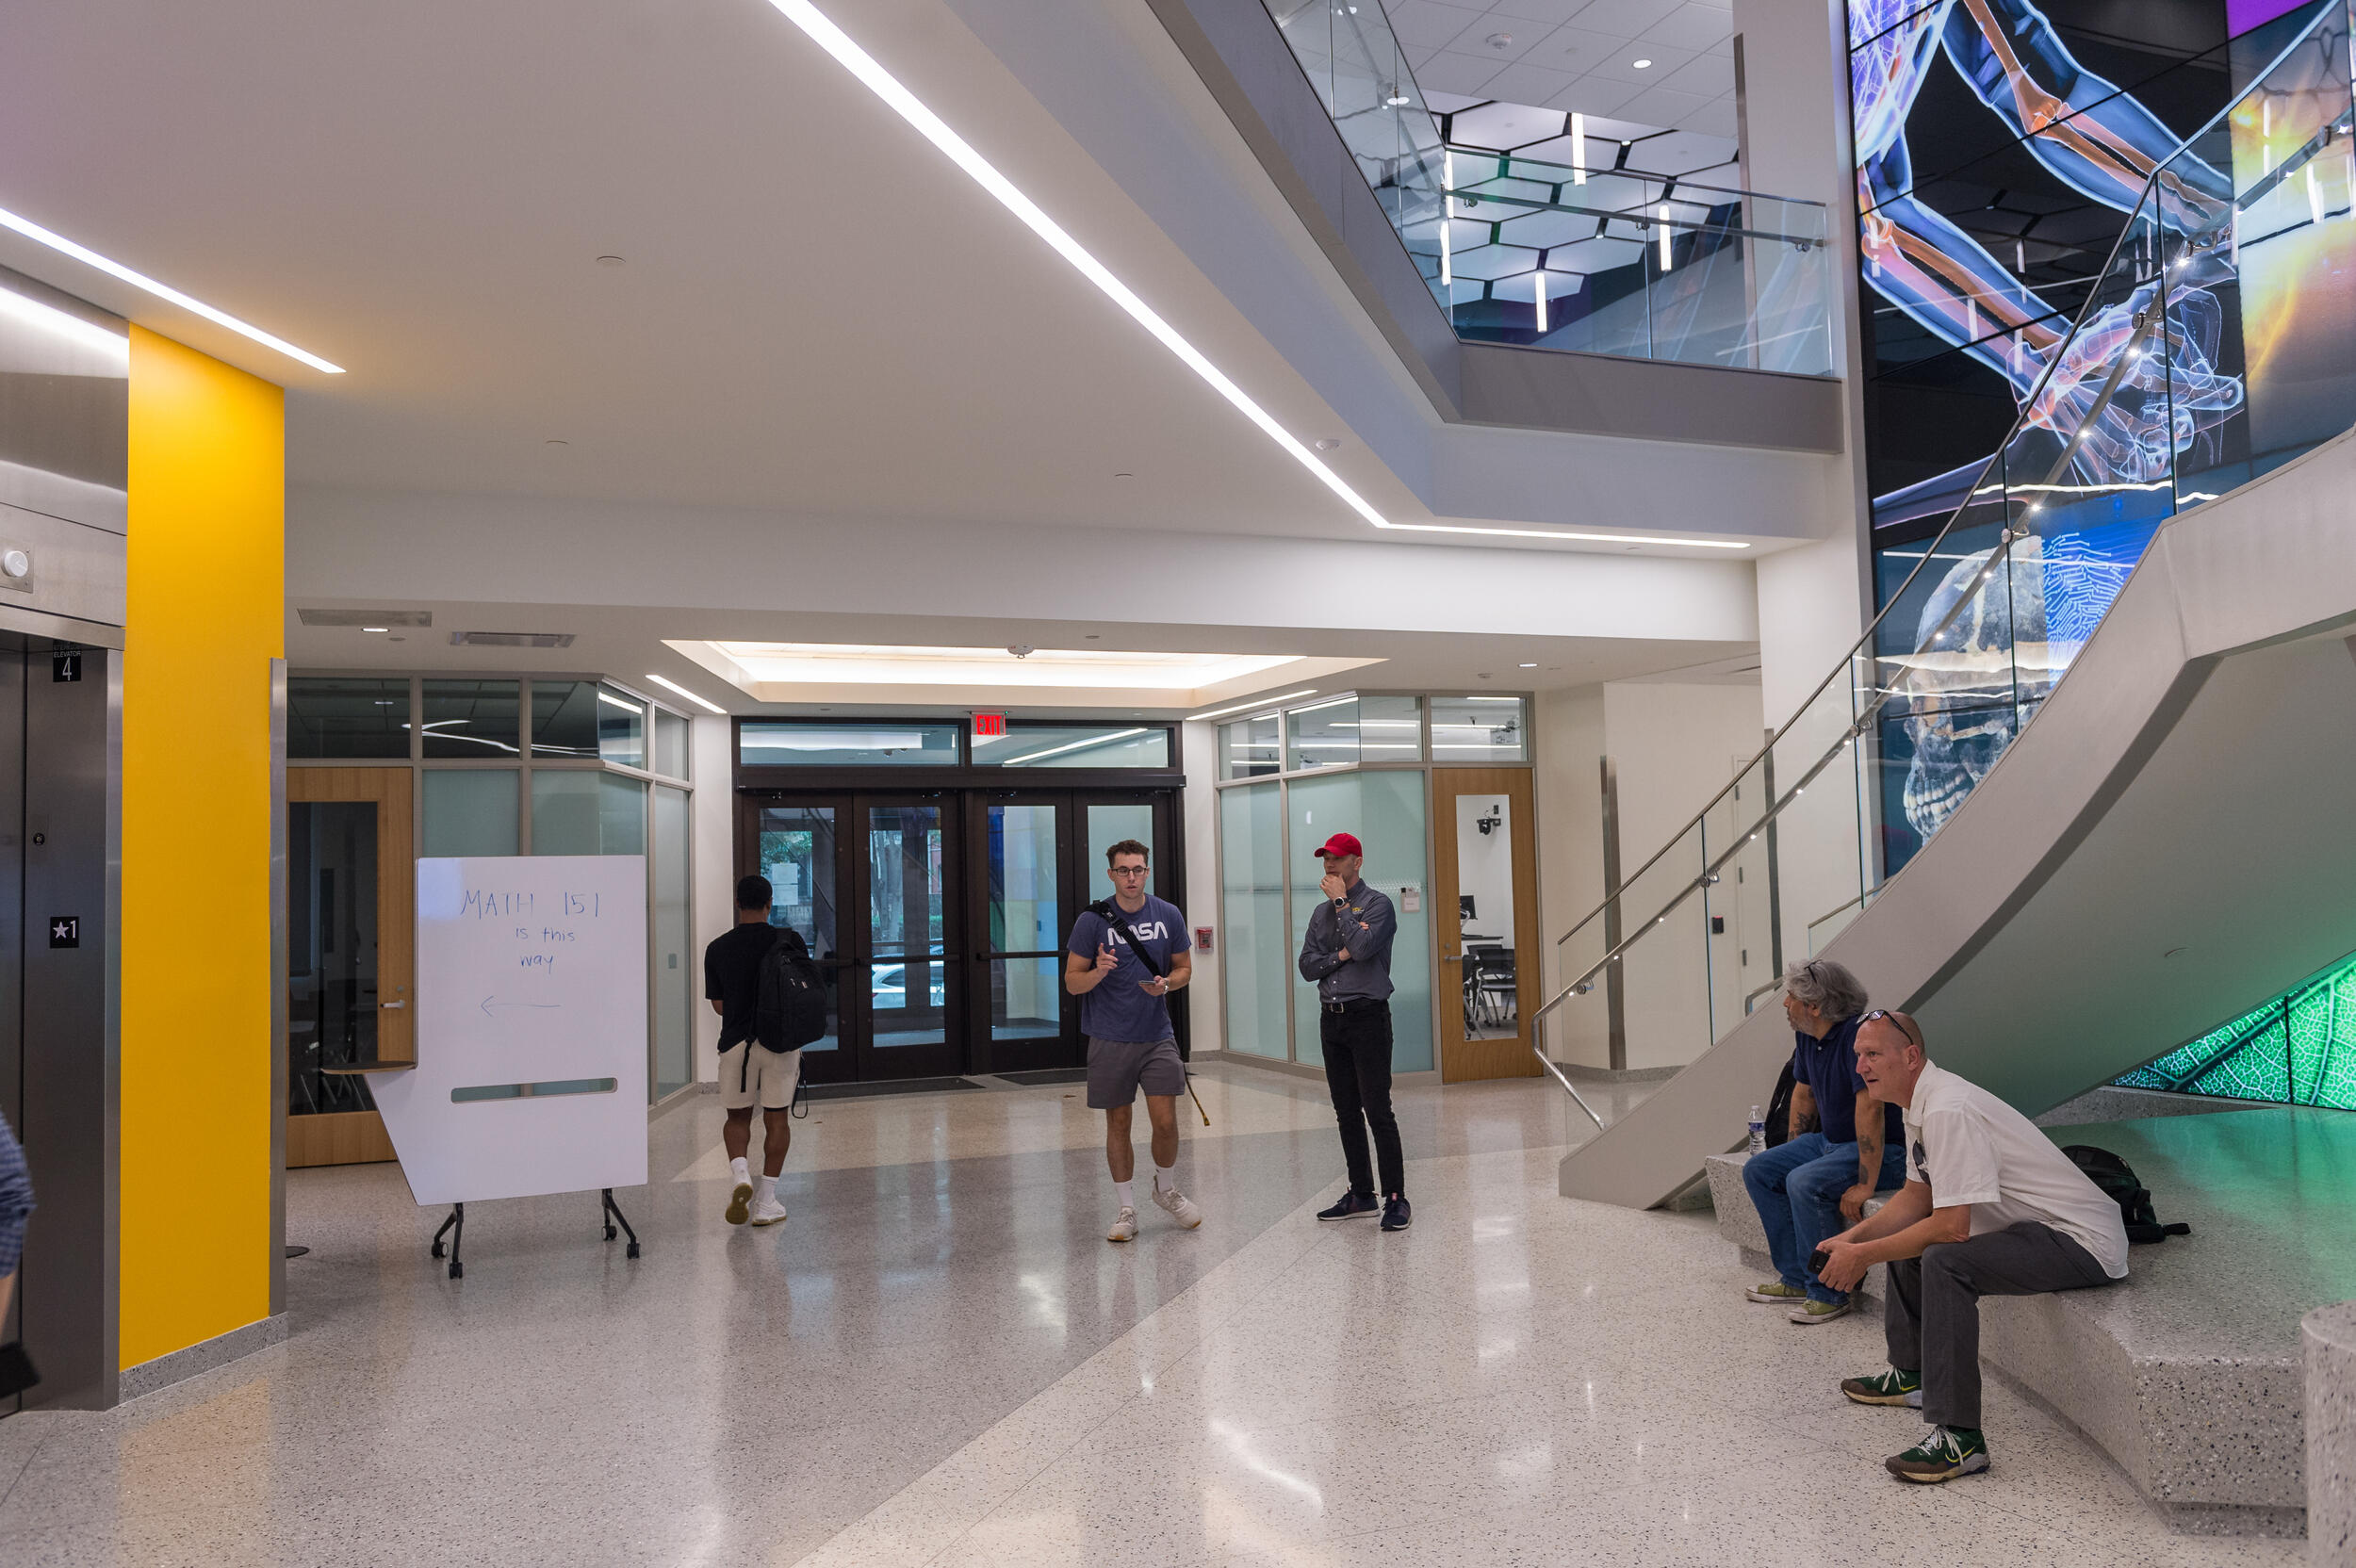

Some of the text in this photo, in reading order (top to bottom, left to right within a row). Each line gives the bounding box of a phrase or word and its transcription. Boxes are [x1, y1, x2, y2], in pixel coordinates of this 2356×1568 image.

[62, 656, 72, 681] 4
[976, 715, 1002, 735] EXIT
[460, 890, 598, 920] MATH 151
[70, 920, 75, 939] 1
[541, 927, 575, 942] this
[520, 955, 553, 974] way
